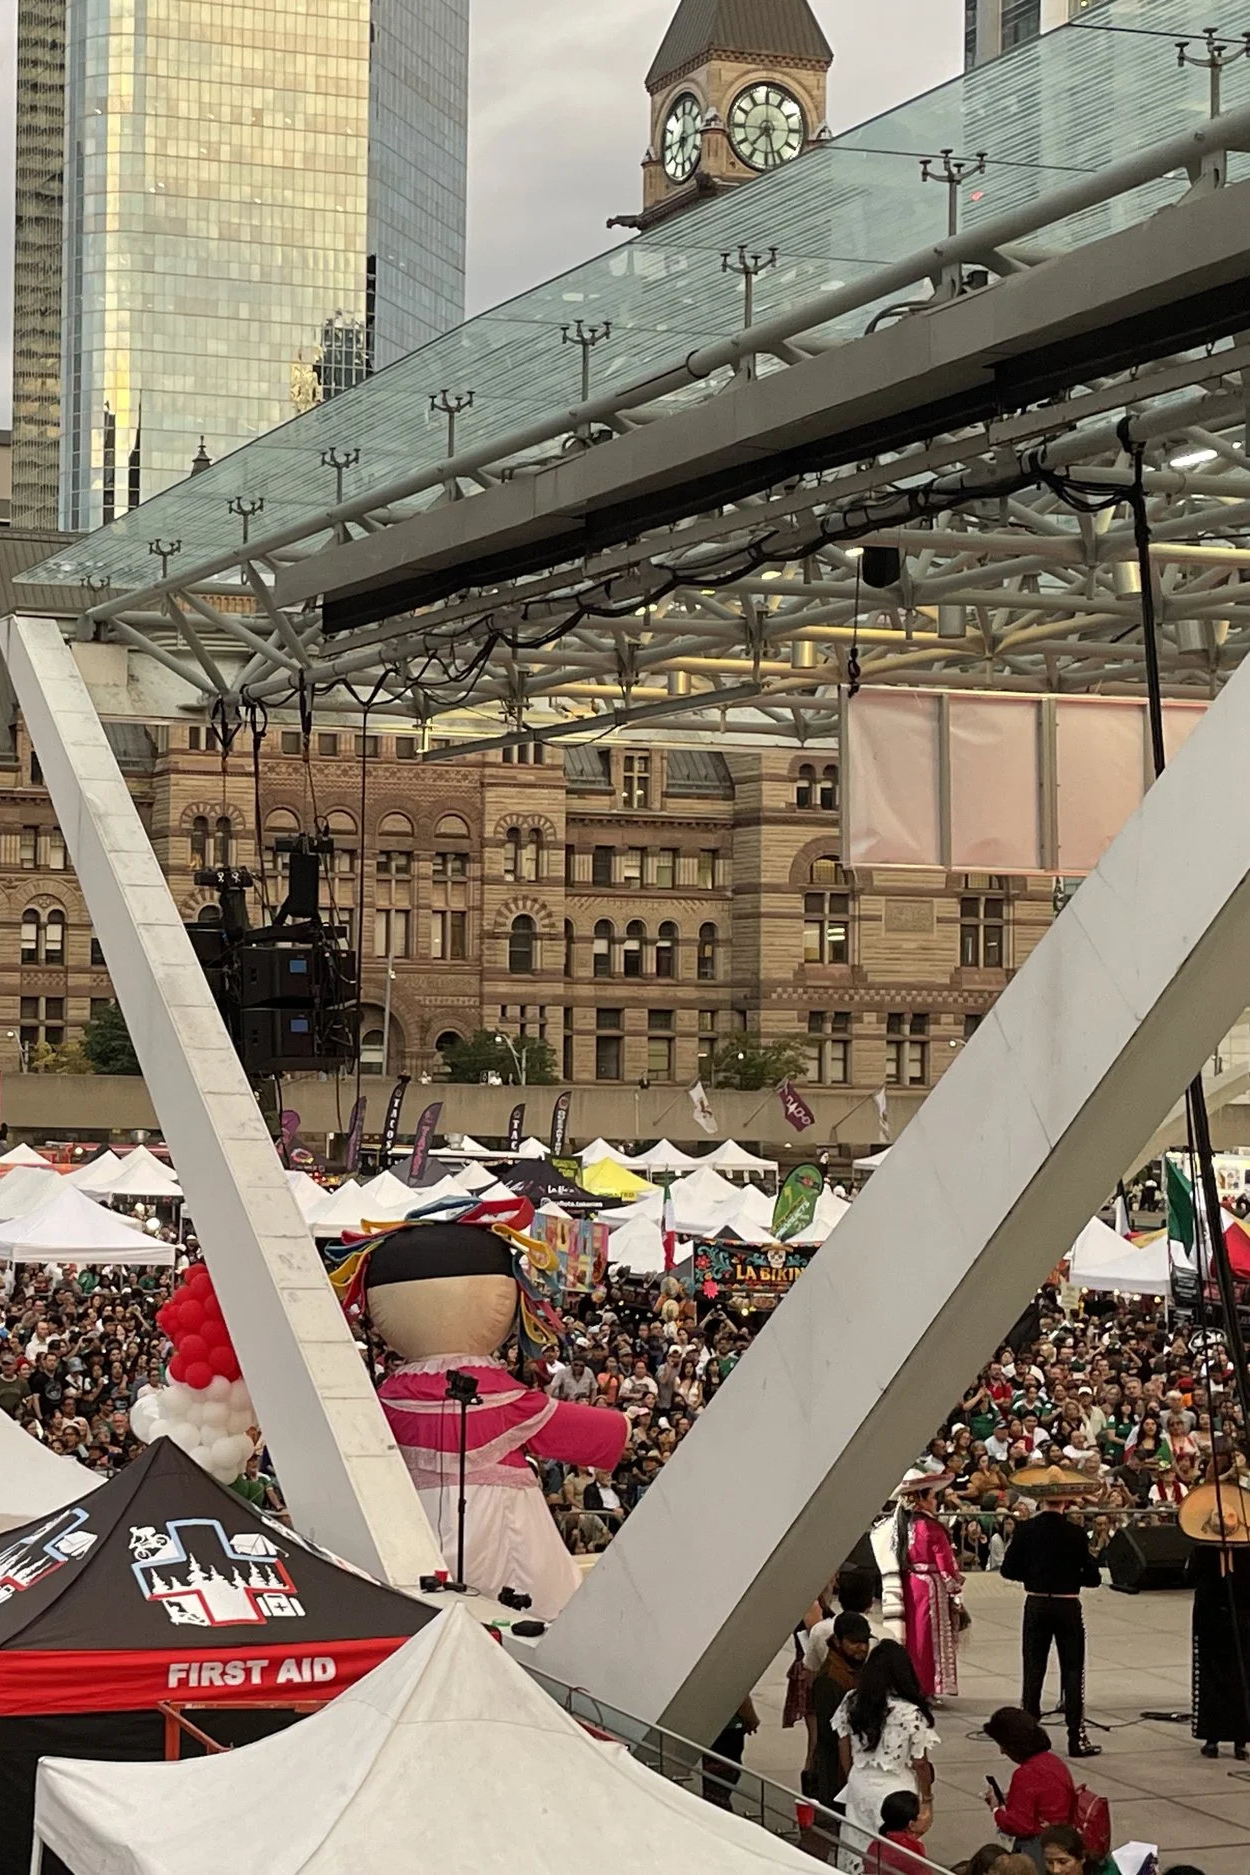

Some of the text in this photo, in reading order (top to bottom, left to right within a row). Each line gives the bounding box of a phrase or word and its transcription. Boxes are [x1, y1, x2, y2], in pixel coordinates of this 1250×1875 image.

[385, 1097, 401, 1149] TACOS
[736, 1264, 757, 1280] LA
[168, 1657, 337, 1688] FIRST AID
